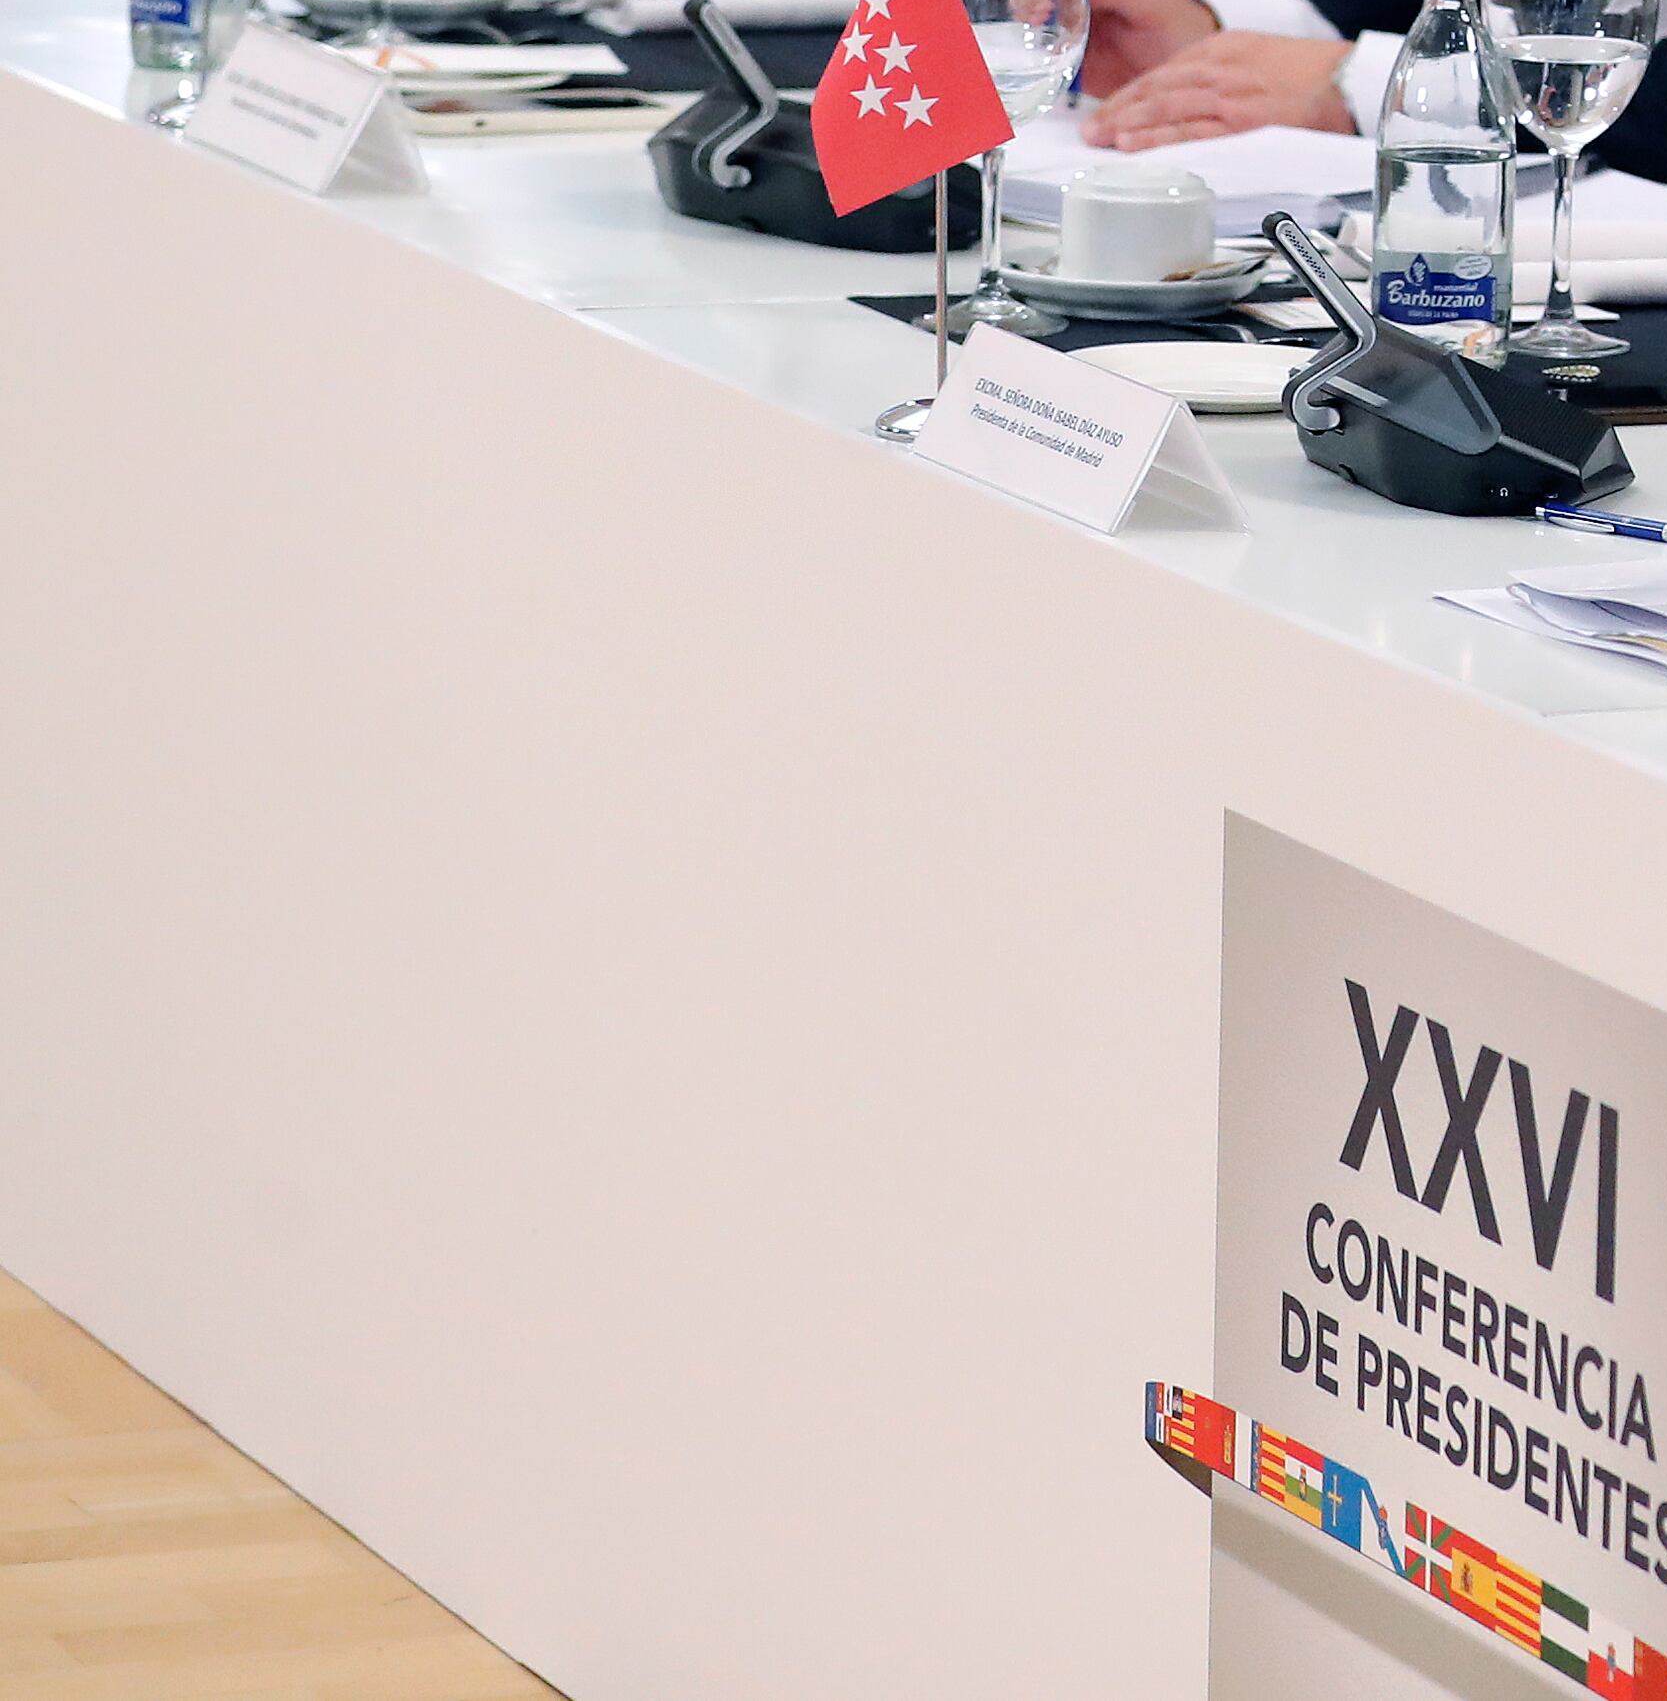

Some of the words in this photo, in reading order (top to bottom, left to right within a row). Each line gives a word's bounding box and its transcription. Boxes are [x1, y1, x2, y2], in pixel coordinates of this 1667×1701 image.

[1387, 279, 1486, 308] Barbuzano
[1096, 427, 1124, 448] AYUSO
[1339, 977, 1620, 1304] XXVI
[1281, 1291, 1340, 1397] DE
[1306, 1202, 1657, 1463] CONFERENCIA
